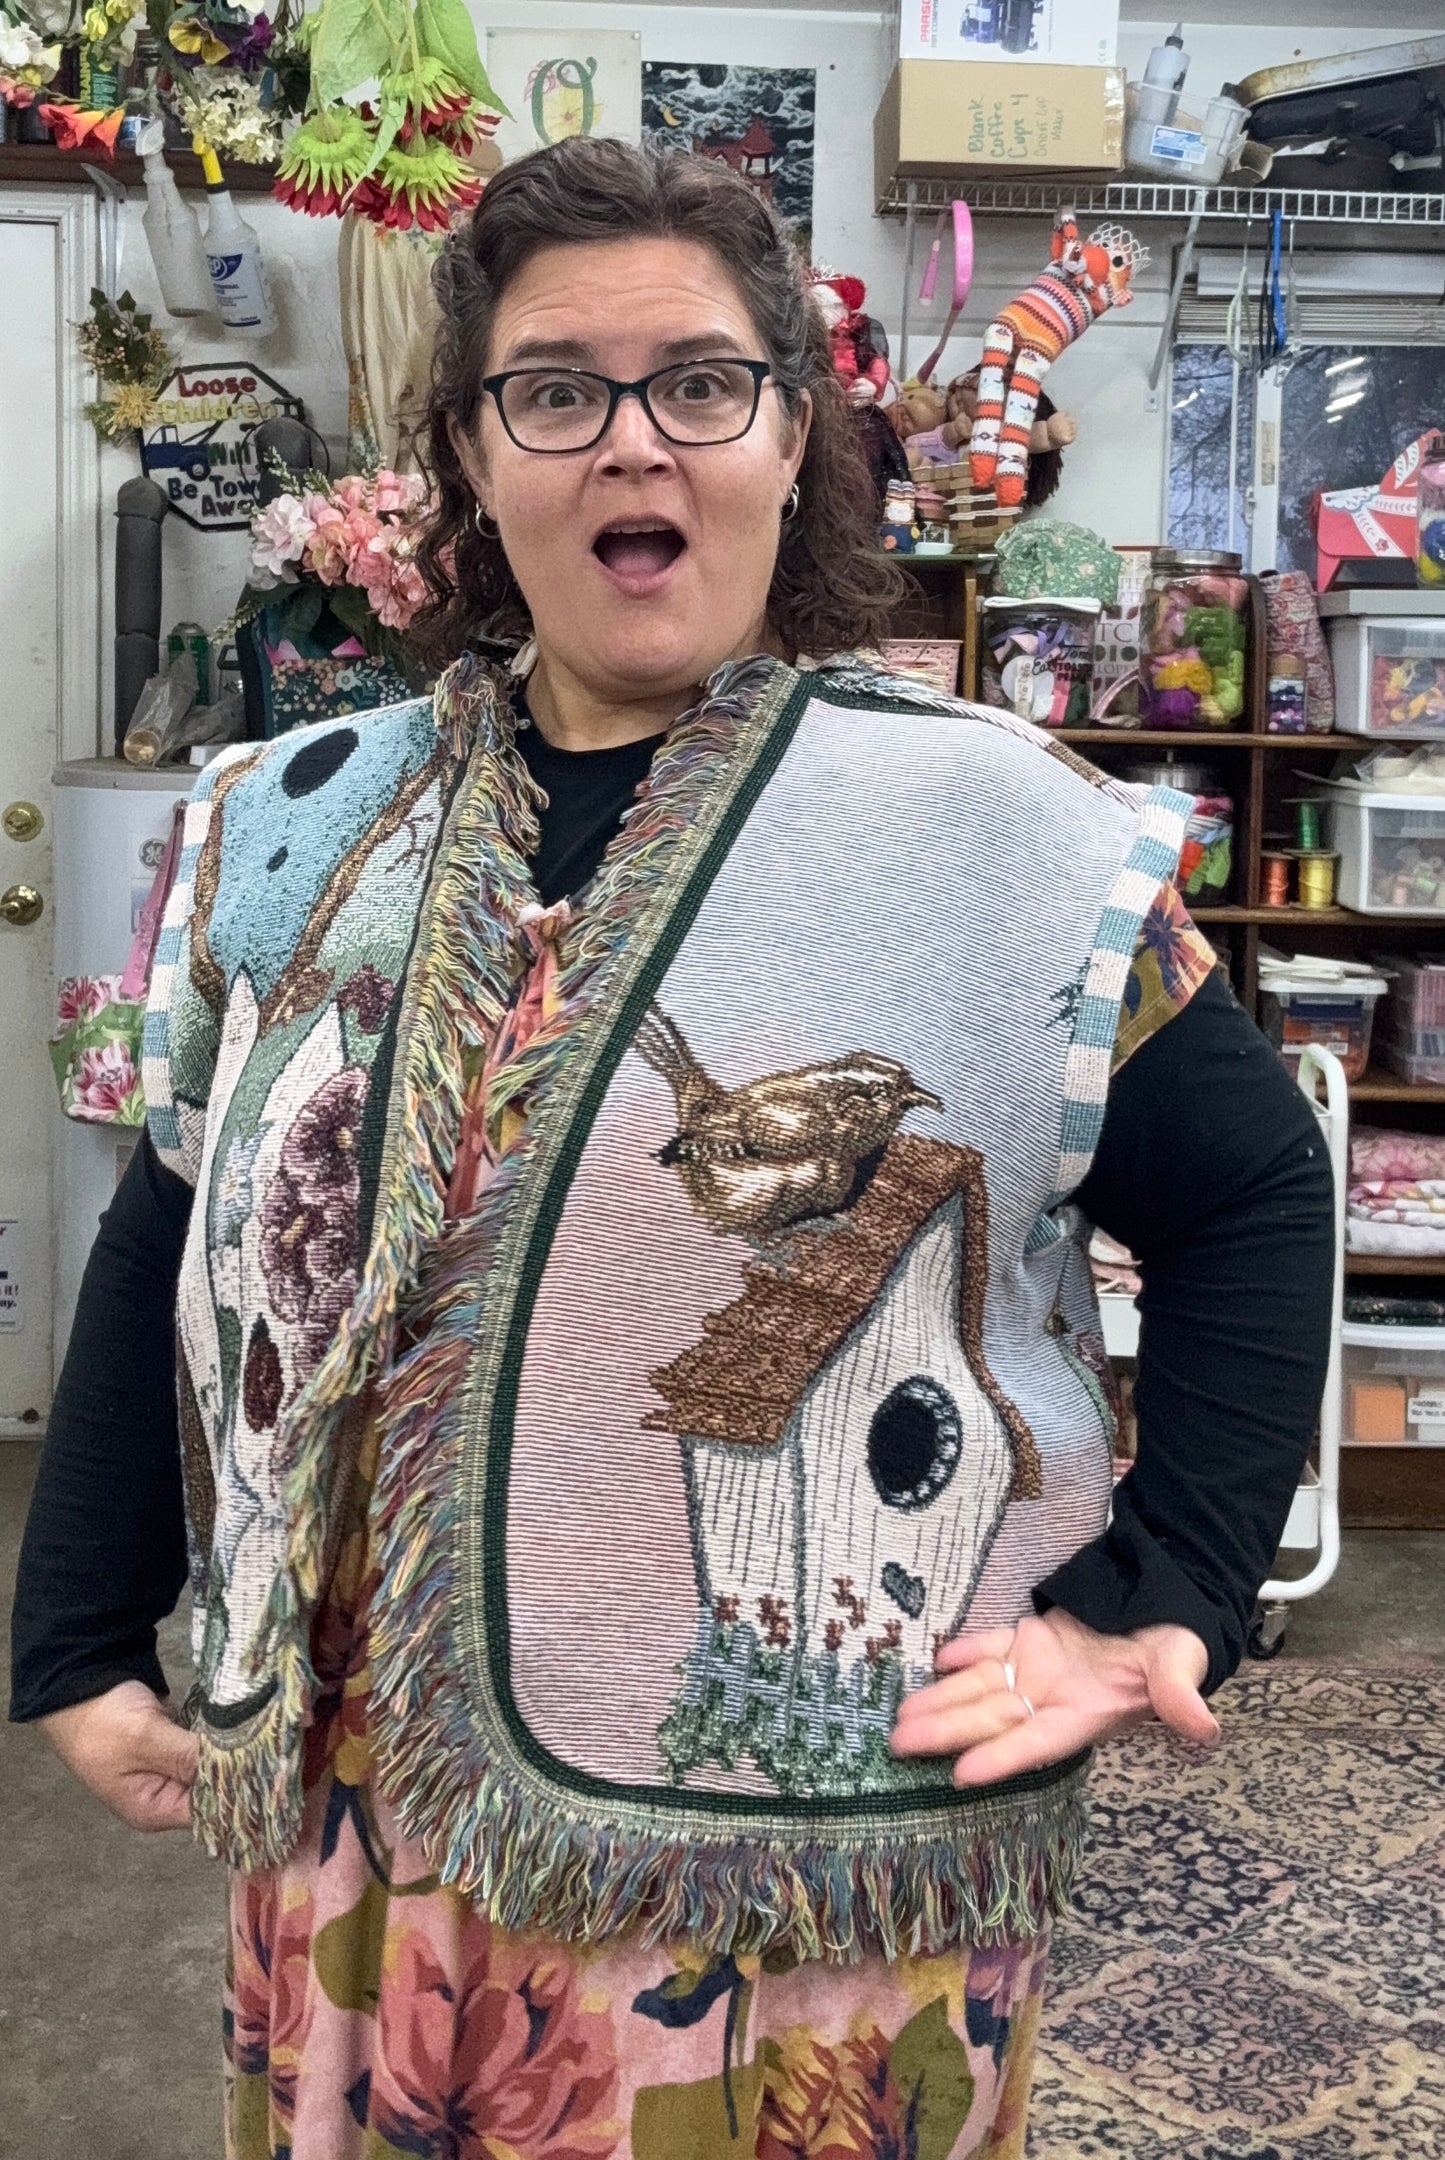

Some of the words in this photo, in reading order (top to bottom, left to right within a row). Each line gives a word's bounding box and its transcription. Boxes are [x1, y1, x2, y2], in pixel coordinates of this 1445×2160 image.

[967, 95, 984, 153] Blank
[1006, 118, 1033, 158] Cups
[177, 374, 258, 398] Loose
[160, 397, 279, 424] Children
[207, 441, 253, 467] Will
[167, 477, 199, 500] Be
[209, 475, 257, 499] Tow
[201, 494, 252, 518] Awa
